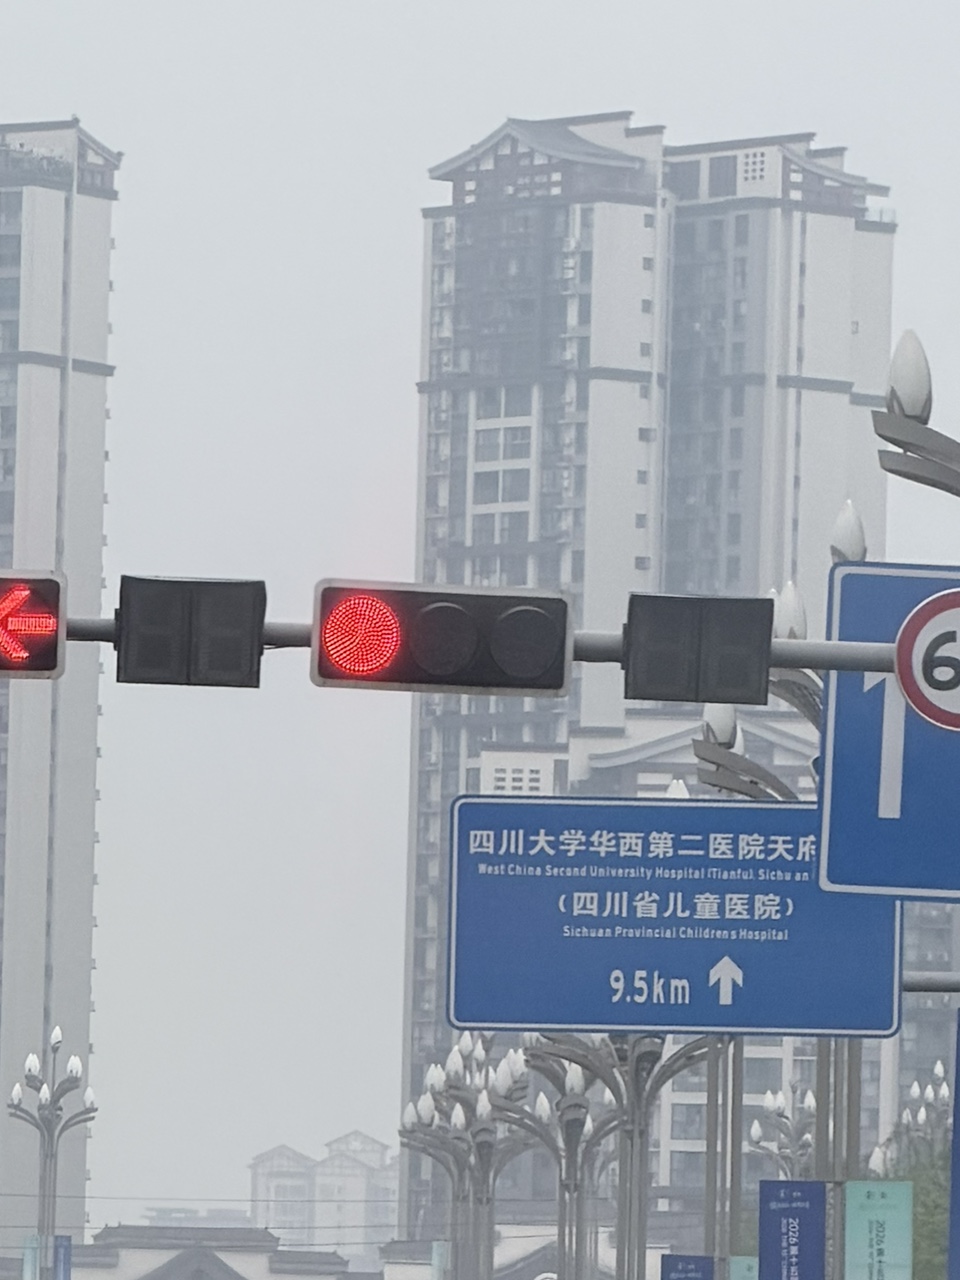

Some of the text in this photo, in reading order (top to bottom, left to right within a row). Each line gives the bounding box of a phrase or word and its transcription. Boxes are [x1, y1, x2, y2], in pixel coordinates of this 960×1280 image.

[469, 828, 817, 862] 四川大学华西第二医院天府
[478, 863, 505, 875] West
[507, 864, 542, 876] China
[545, 865, 587, 877] Second
[589, 865, 653, 880] University
[655, 867, 705, 880] Hospital
[563, 925, 612, 938] Sichuan
[614, 926, 676, 939] Provincial
[739, 928, 788, 942] Hospital
[609, 969, 690, 1004] 9.5km
